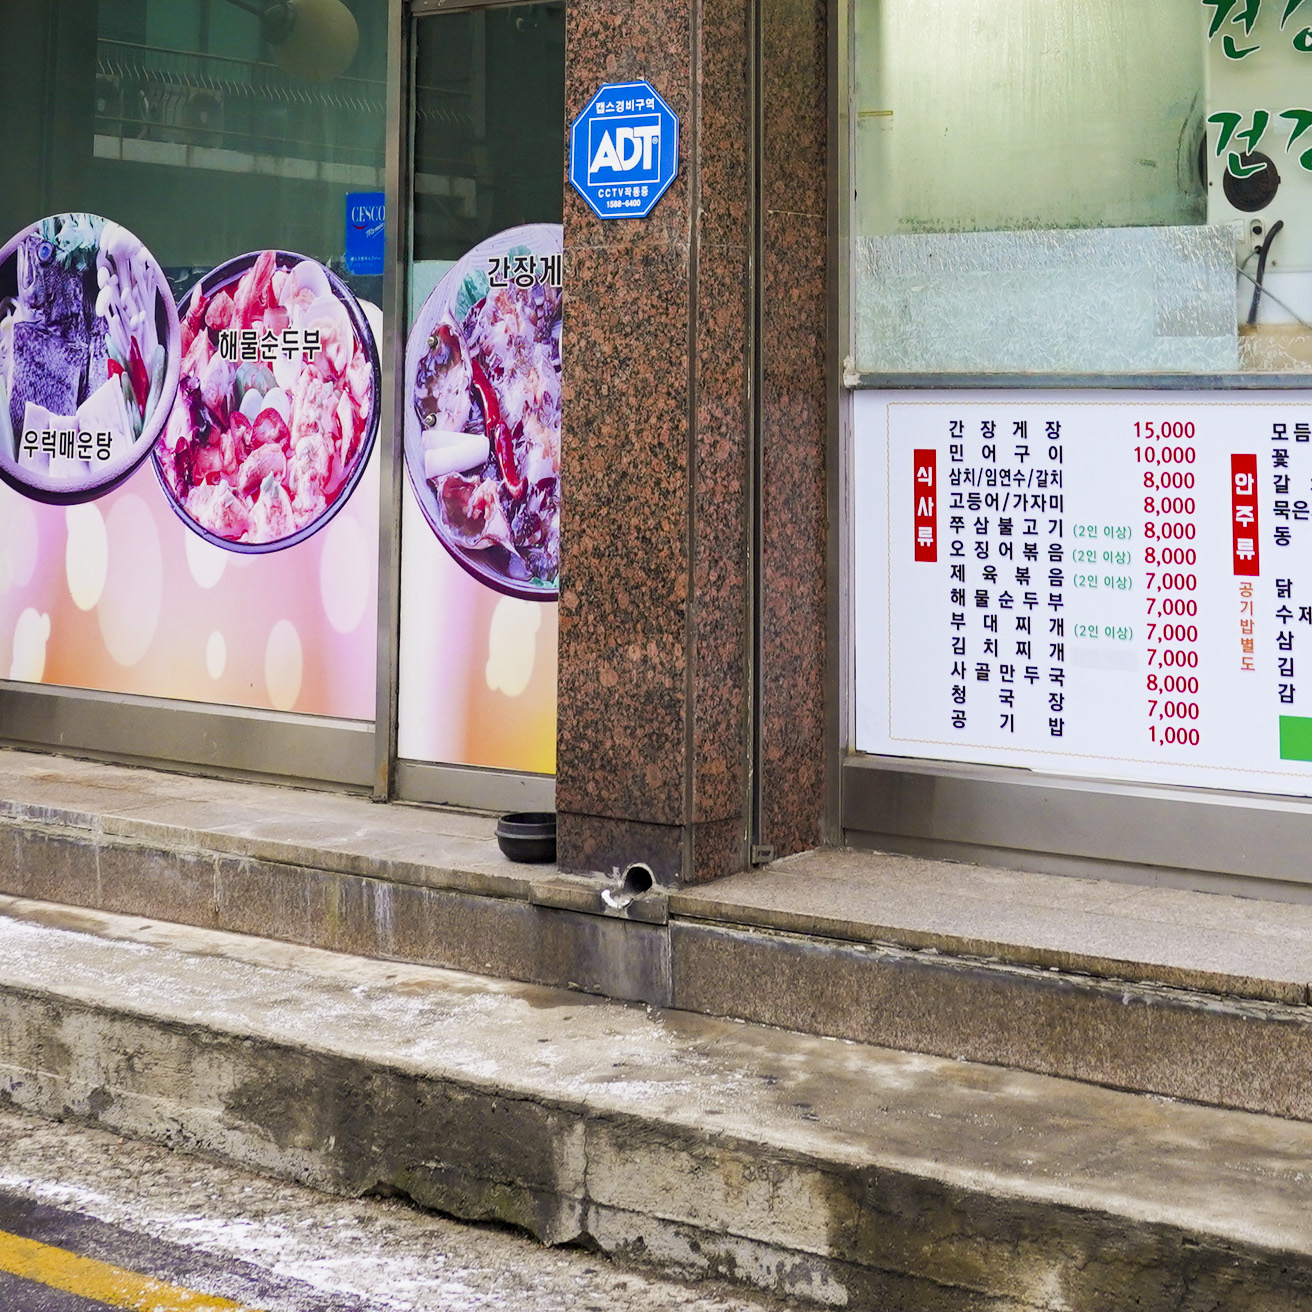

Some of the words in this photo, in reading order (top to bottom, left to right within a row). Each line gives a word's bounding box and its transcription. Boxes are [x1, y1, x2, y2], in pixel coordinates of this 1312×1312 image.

[596, 98, 655, 114] 캡스경비구역
[589, 125, 660, 173] ADT
[598, 186, 648, 198] CCTV작동중
[351, 205, 386, 223] CESCO
[606, 199, 641, 209] 1588-6400
[217, 330, 322, 363] 해물순두부
[1133, 421, 1196, 441] 15,000
[22, 430, 114, 462] 우럭매운탕
[1134, 446, 1196, 466] 10,000
[949, 468, 1063, 488] 삼치/임연수/갈치
[1143, 471, 1195, 491] 8,000
[916, 466, 935, 547] 식사류
[949, 492, 1064, 513] 고등어/가자미
[1144, 496, 1196, 516] 8,000
[1234, 472, 1255, 561] 안주류
[1073, 524, 1097, 538] (2인
[1103, 526, 1132, 540] 이상)
[1144, 521, 1196, 542] 8,000
[1072, 549, 1096, 563] (2인
[1103, 551, 1131, 564] 이상)
[1144, 546, 1197, 567] 8,000
[1073, 574, 1098, 588] (2인
[1104, 576, 1133, 590] 이상)
[1145, 573, 1197, 592] 7,000
[1146, 598, 1198, 618] 7,000
[1074, 624, 1098, 638] (2인
[1104, 626, 1133, 640] 이상)
[1146, 623, 1198, 643] 7,000
[1239, 581, 1256, 671] 공기밥별도
[1147, 649, 1199, 669] 7,000
[1146, 674, 1199, 694] 8,000
[1147, 699, 1200, 720] 7,000
[1148, 725, 1200, 746] 1,000
